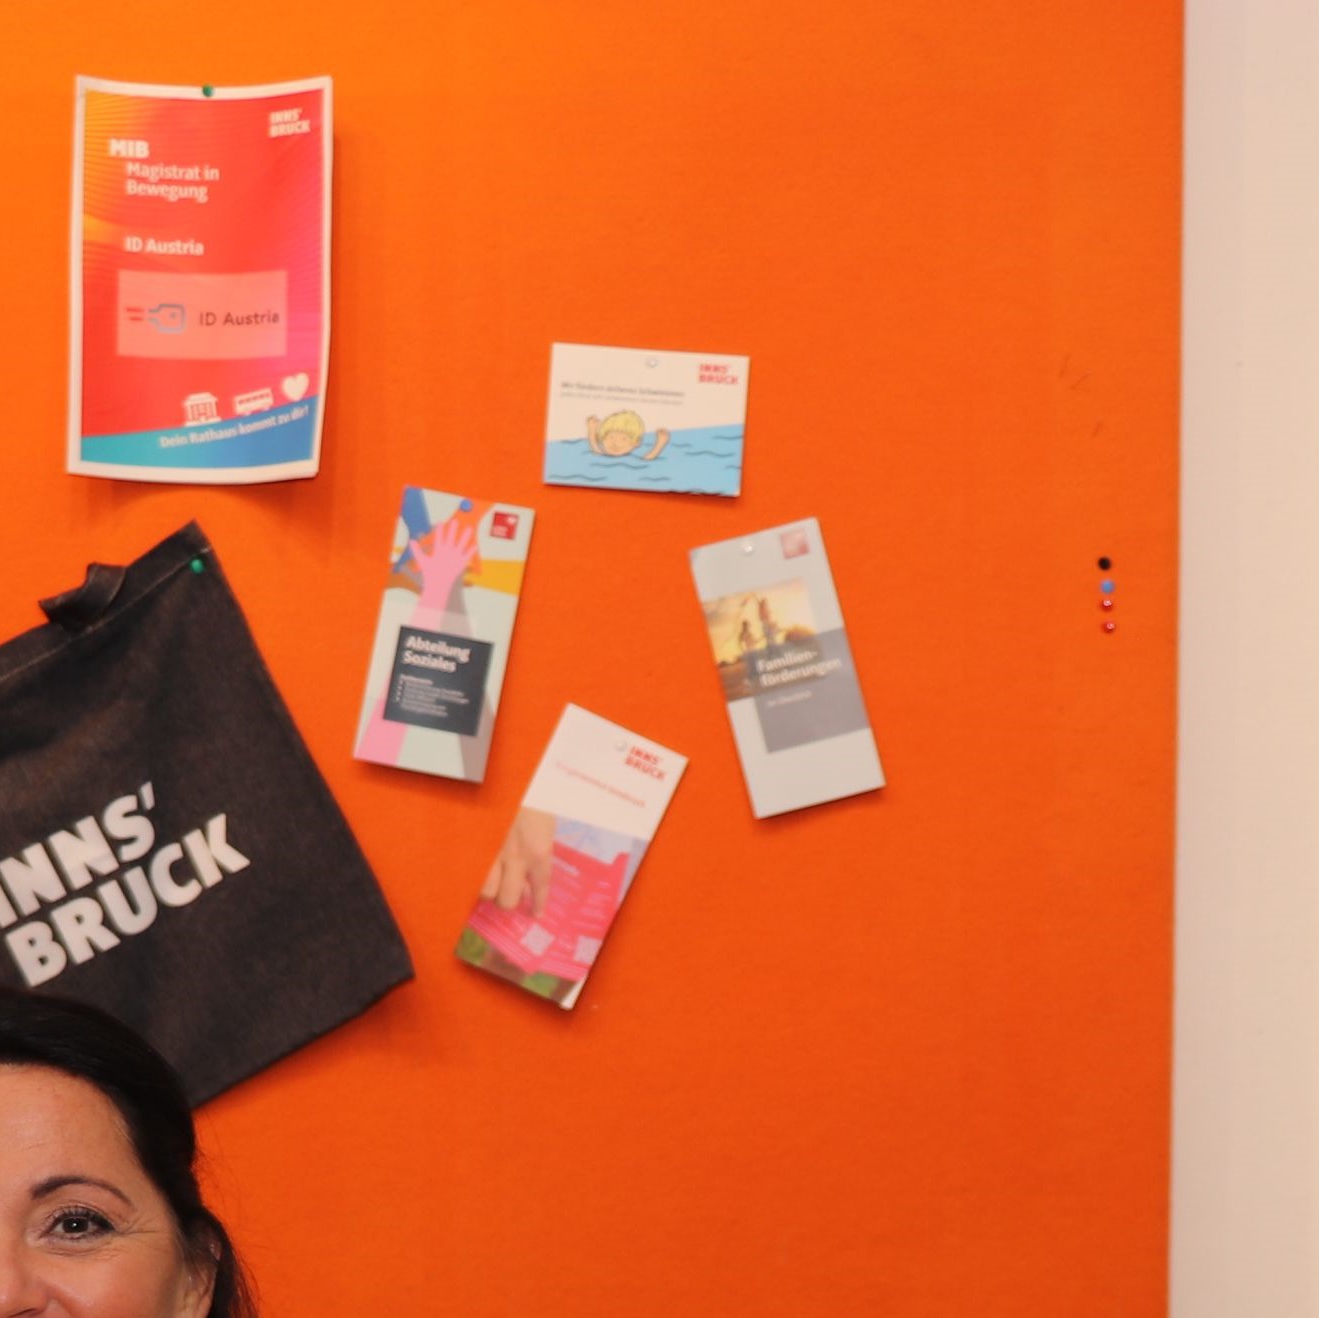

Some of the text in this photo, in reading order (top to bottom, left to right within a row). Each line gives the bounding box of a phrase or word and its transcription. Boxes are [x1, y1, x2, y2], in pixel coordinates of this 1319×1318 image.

[109, 138, 149, 159] MIB
[125, 162, 219, 184] Magistrat in
[125, 180, 208, 203] Bewegung
[125, 236, 205, 256] ID Austria
[199, 309, 281, 327] ID Austria
[159, 432, 189, 449] Dein
[189, 425, 239, 447] Rathaus
[237, 415, 276, 436] kommt
[277, 413, 290, 430] zu
[405, 634, 471, 662] Abteilung
[756, 648, 818, 673] Familien-
[403, 649, 457, 674] Soziales
[760, 656, 842, 687] förderungen
[4, 812, 251, 989] BRUCK
